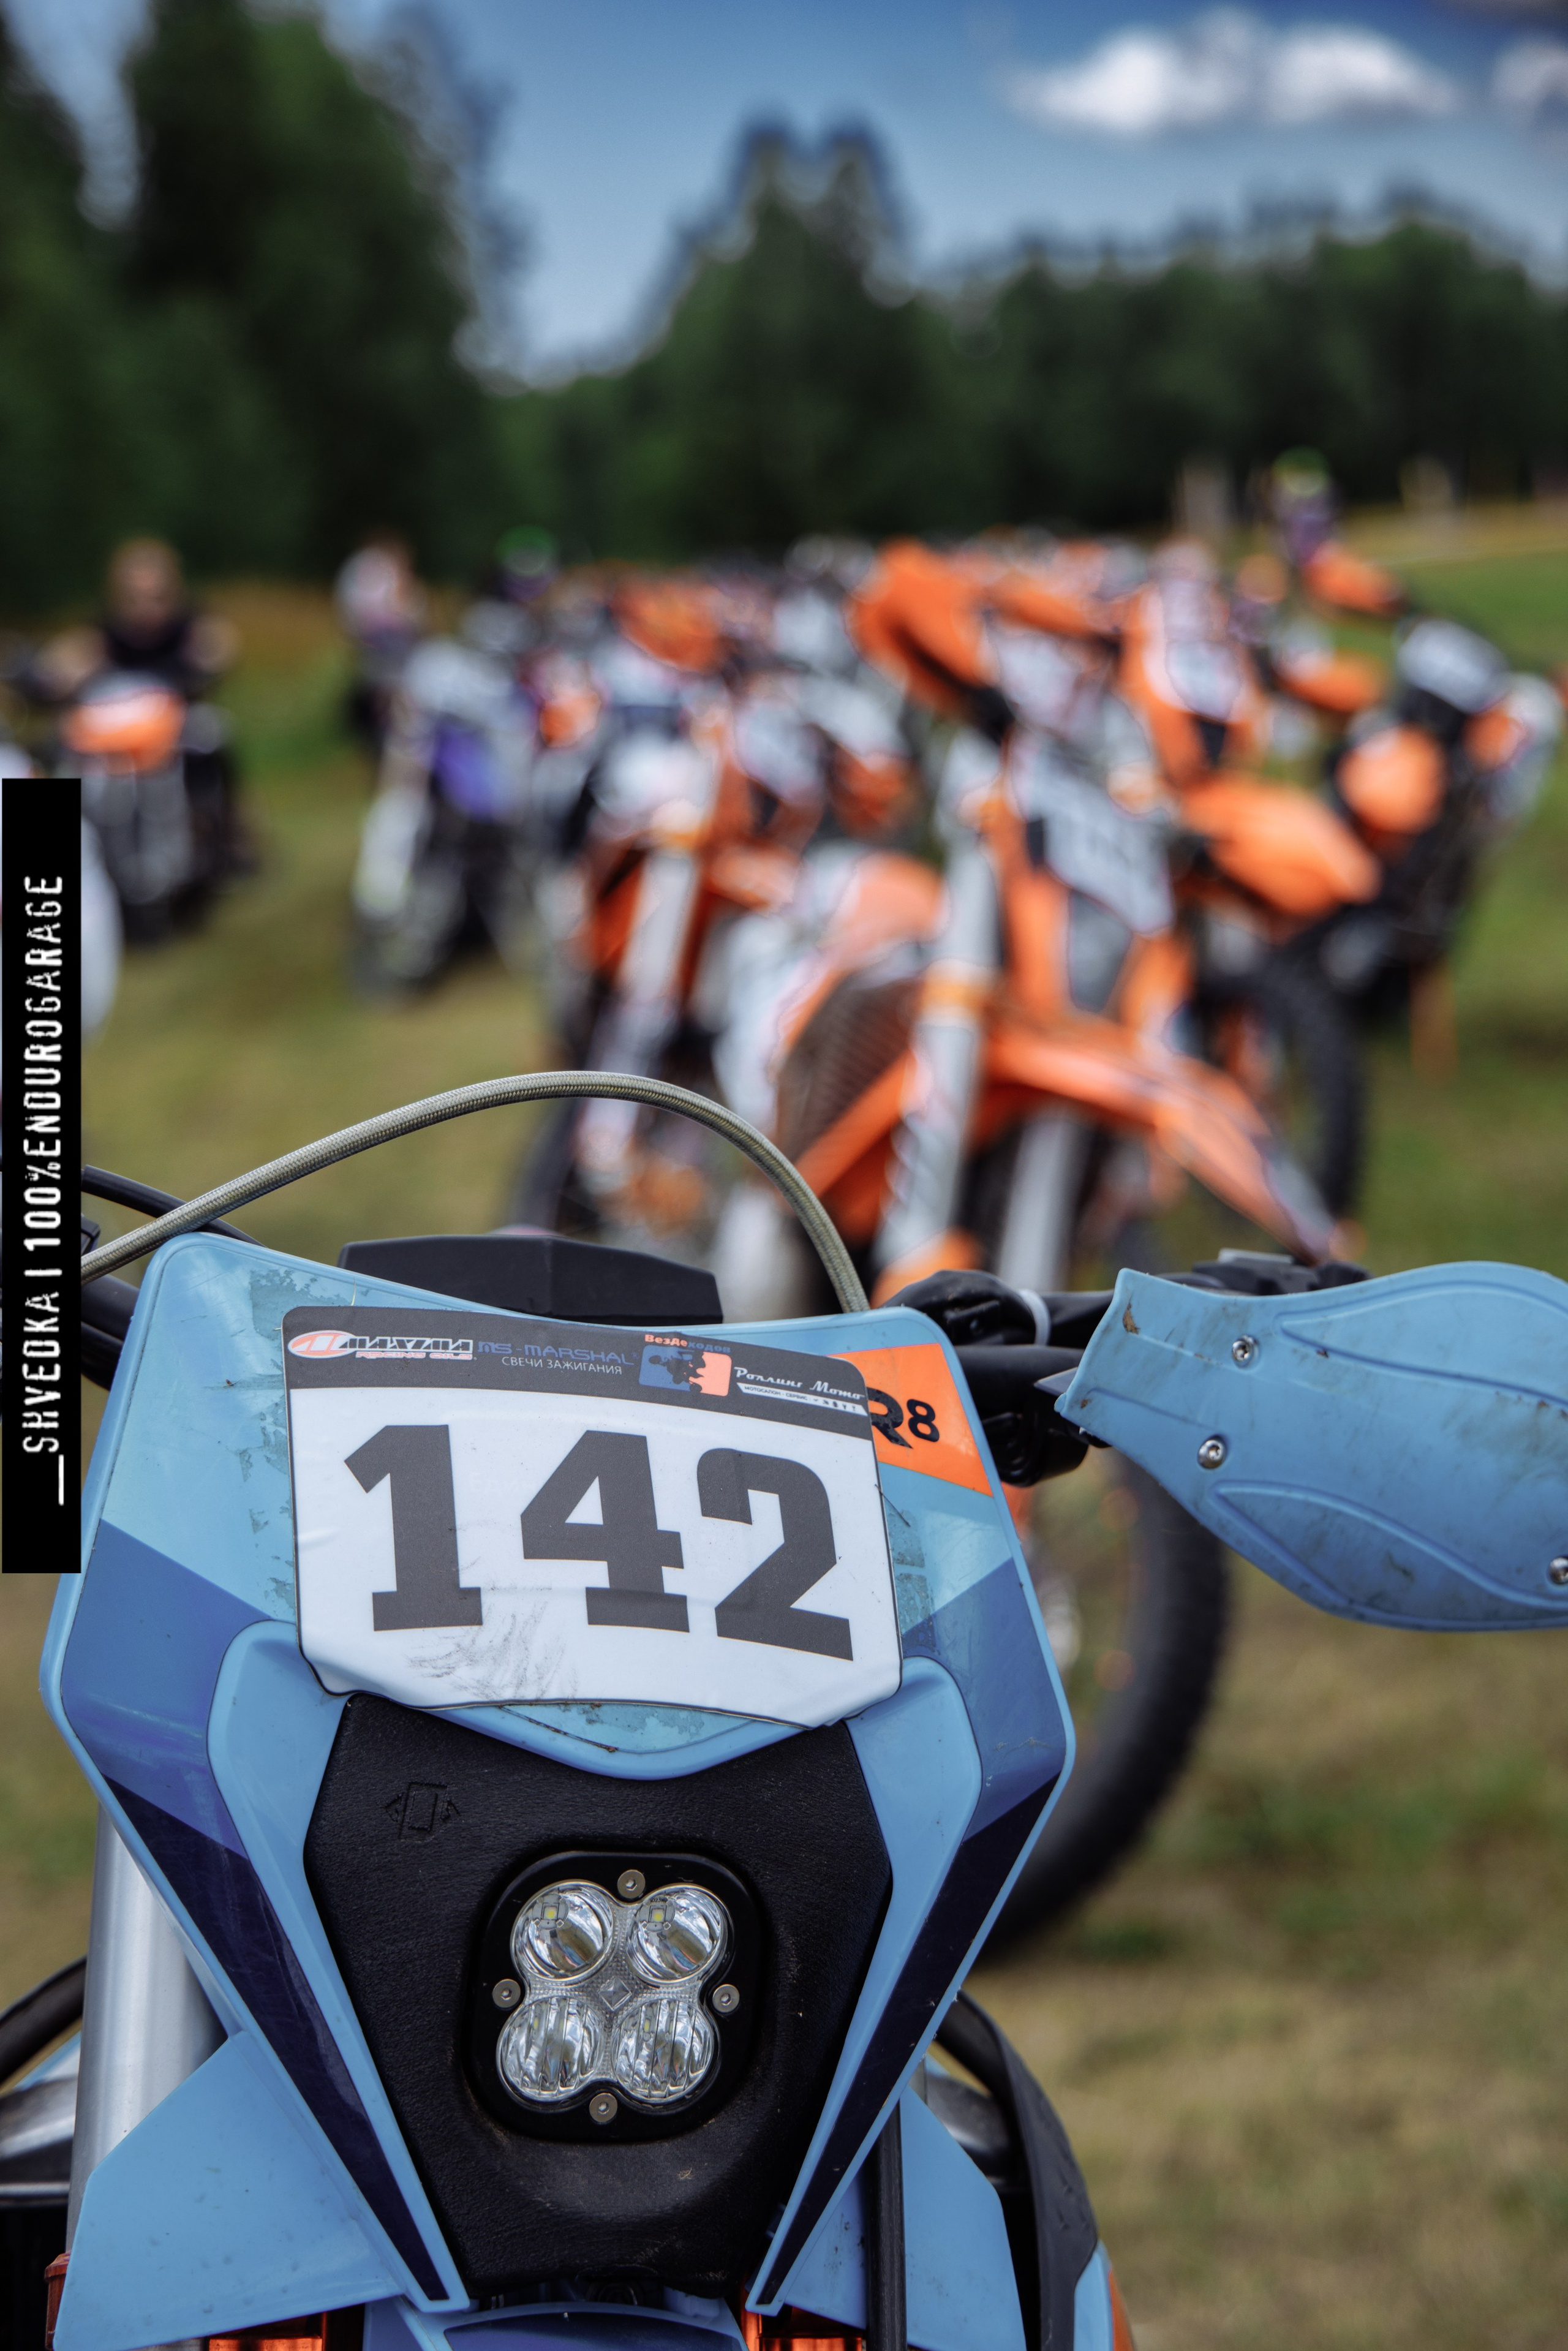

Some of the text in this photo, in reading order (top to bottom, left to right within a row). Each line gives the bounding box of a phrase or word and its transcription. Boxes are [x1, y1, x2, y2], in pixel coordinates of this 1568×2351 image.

[502, 1356, 622, 1375] СВЕЧИ ЗАЖИГАНИЯ
[734, 1367, 865, 1400] Роллинг Мото
[744, 1386, 781, 1396] МОТОСАЛОН
[786, 1392, 808, 1401] СЕРВИС
[344, 1424, 854, 1661] 142
